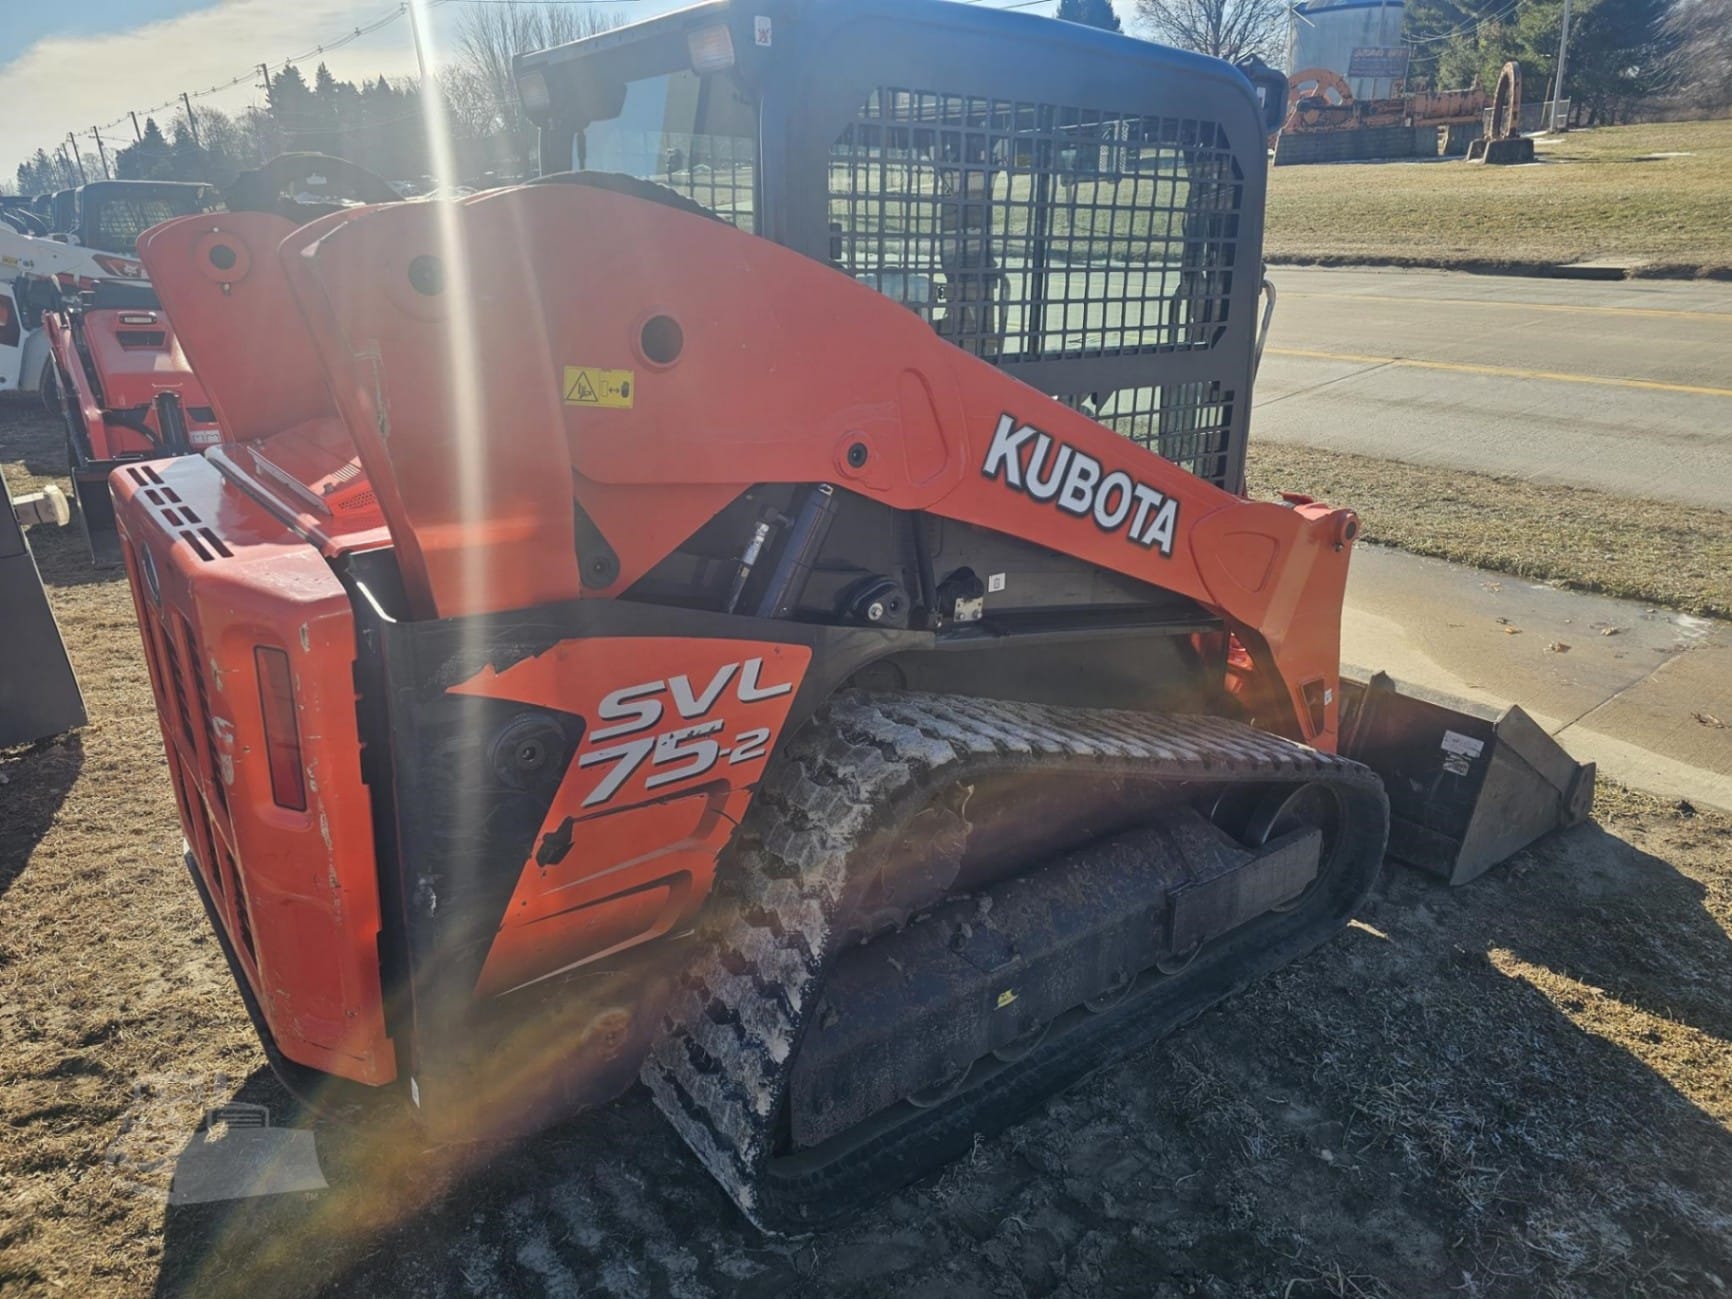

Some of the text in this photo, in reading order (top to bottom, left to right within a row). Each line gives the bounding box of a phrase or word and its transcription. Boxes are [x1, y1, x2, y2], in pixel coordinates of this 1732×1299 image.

[982, 413, 1179, 557] KUBOTA
[589, 657, 793, 743] SVL
[578, 718, 771, 808] 75-2
